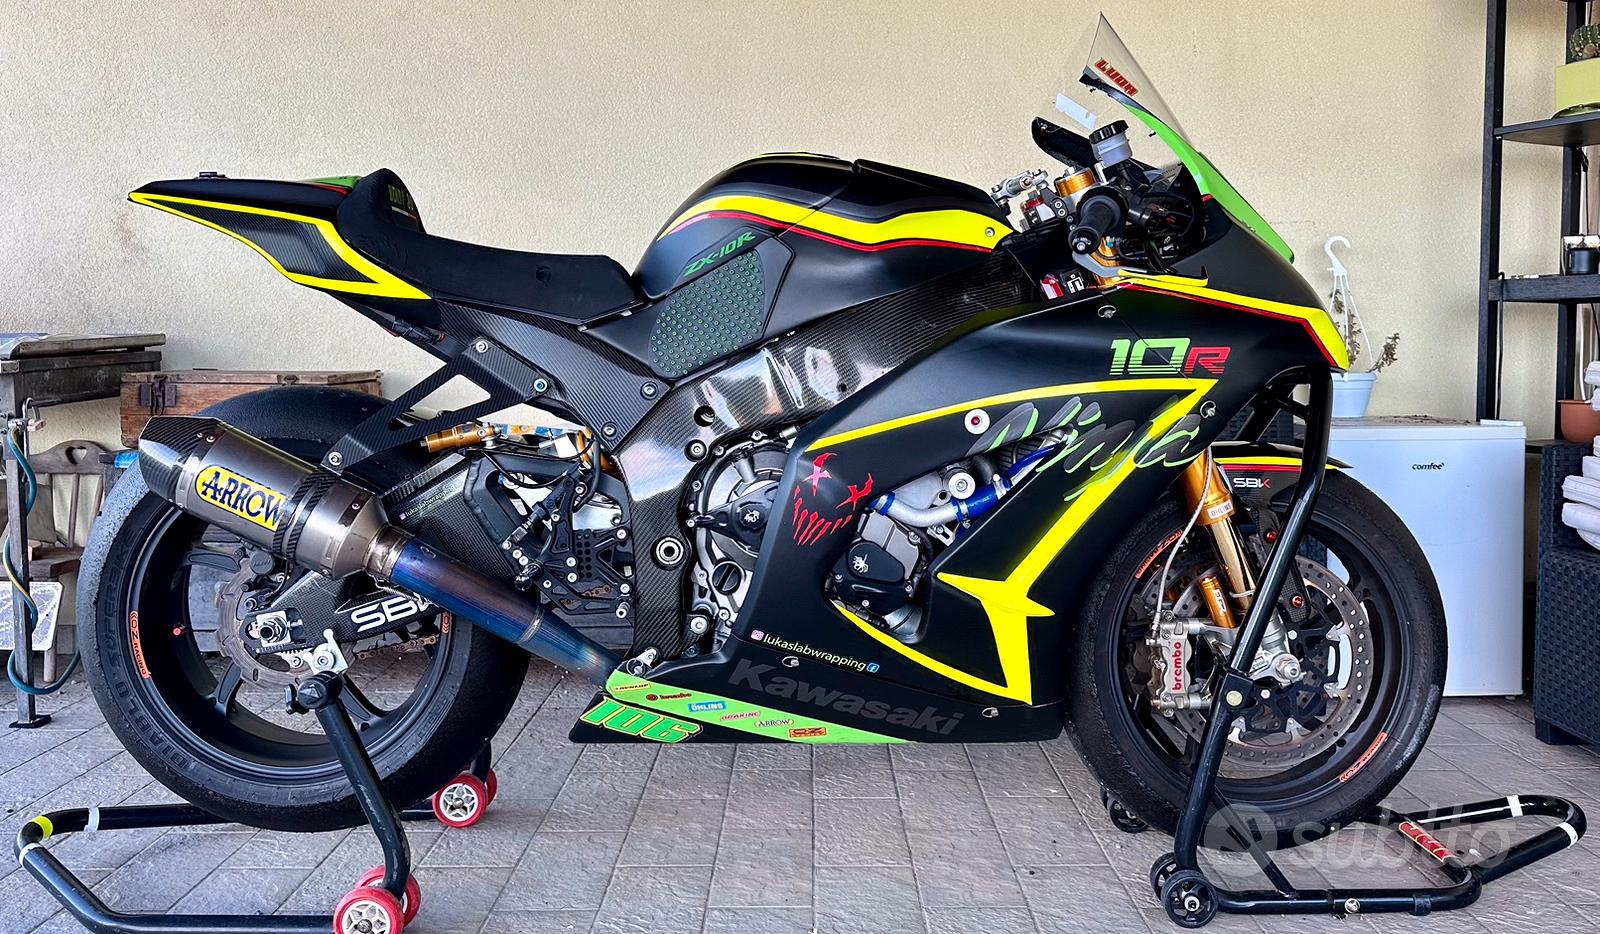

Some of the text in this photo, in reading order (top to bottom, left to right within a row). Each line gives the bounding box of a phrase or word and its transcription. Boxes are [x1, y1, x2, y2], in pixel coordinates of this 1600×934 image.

[683, 231, 756, 277] ZX-10R
[1109, 337, 1231, 375] 10R
[965, 394, 1204, 502] Ninja
[202, 471, 284, 526] ARROW
[1233, 477, 1271, 488] SBK
[763, 633, 866, 672] lukaslabwrapping
[1172, 641, 1182, 690] brembo
[580, 696, 702, 743] 106
[728, 658, 965, 735] Kawasaki
